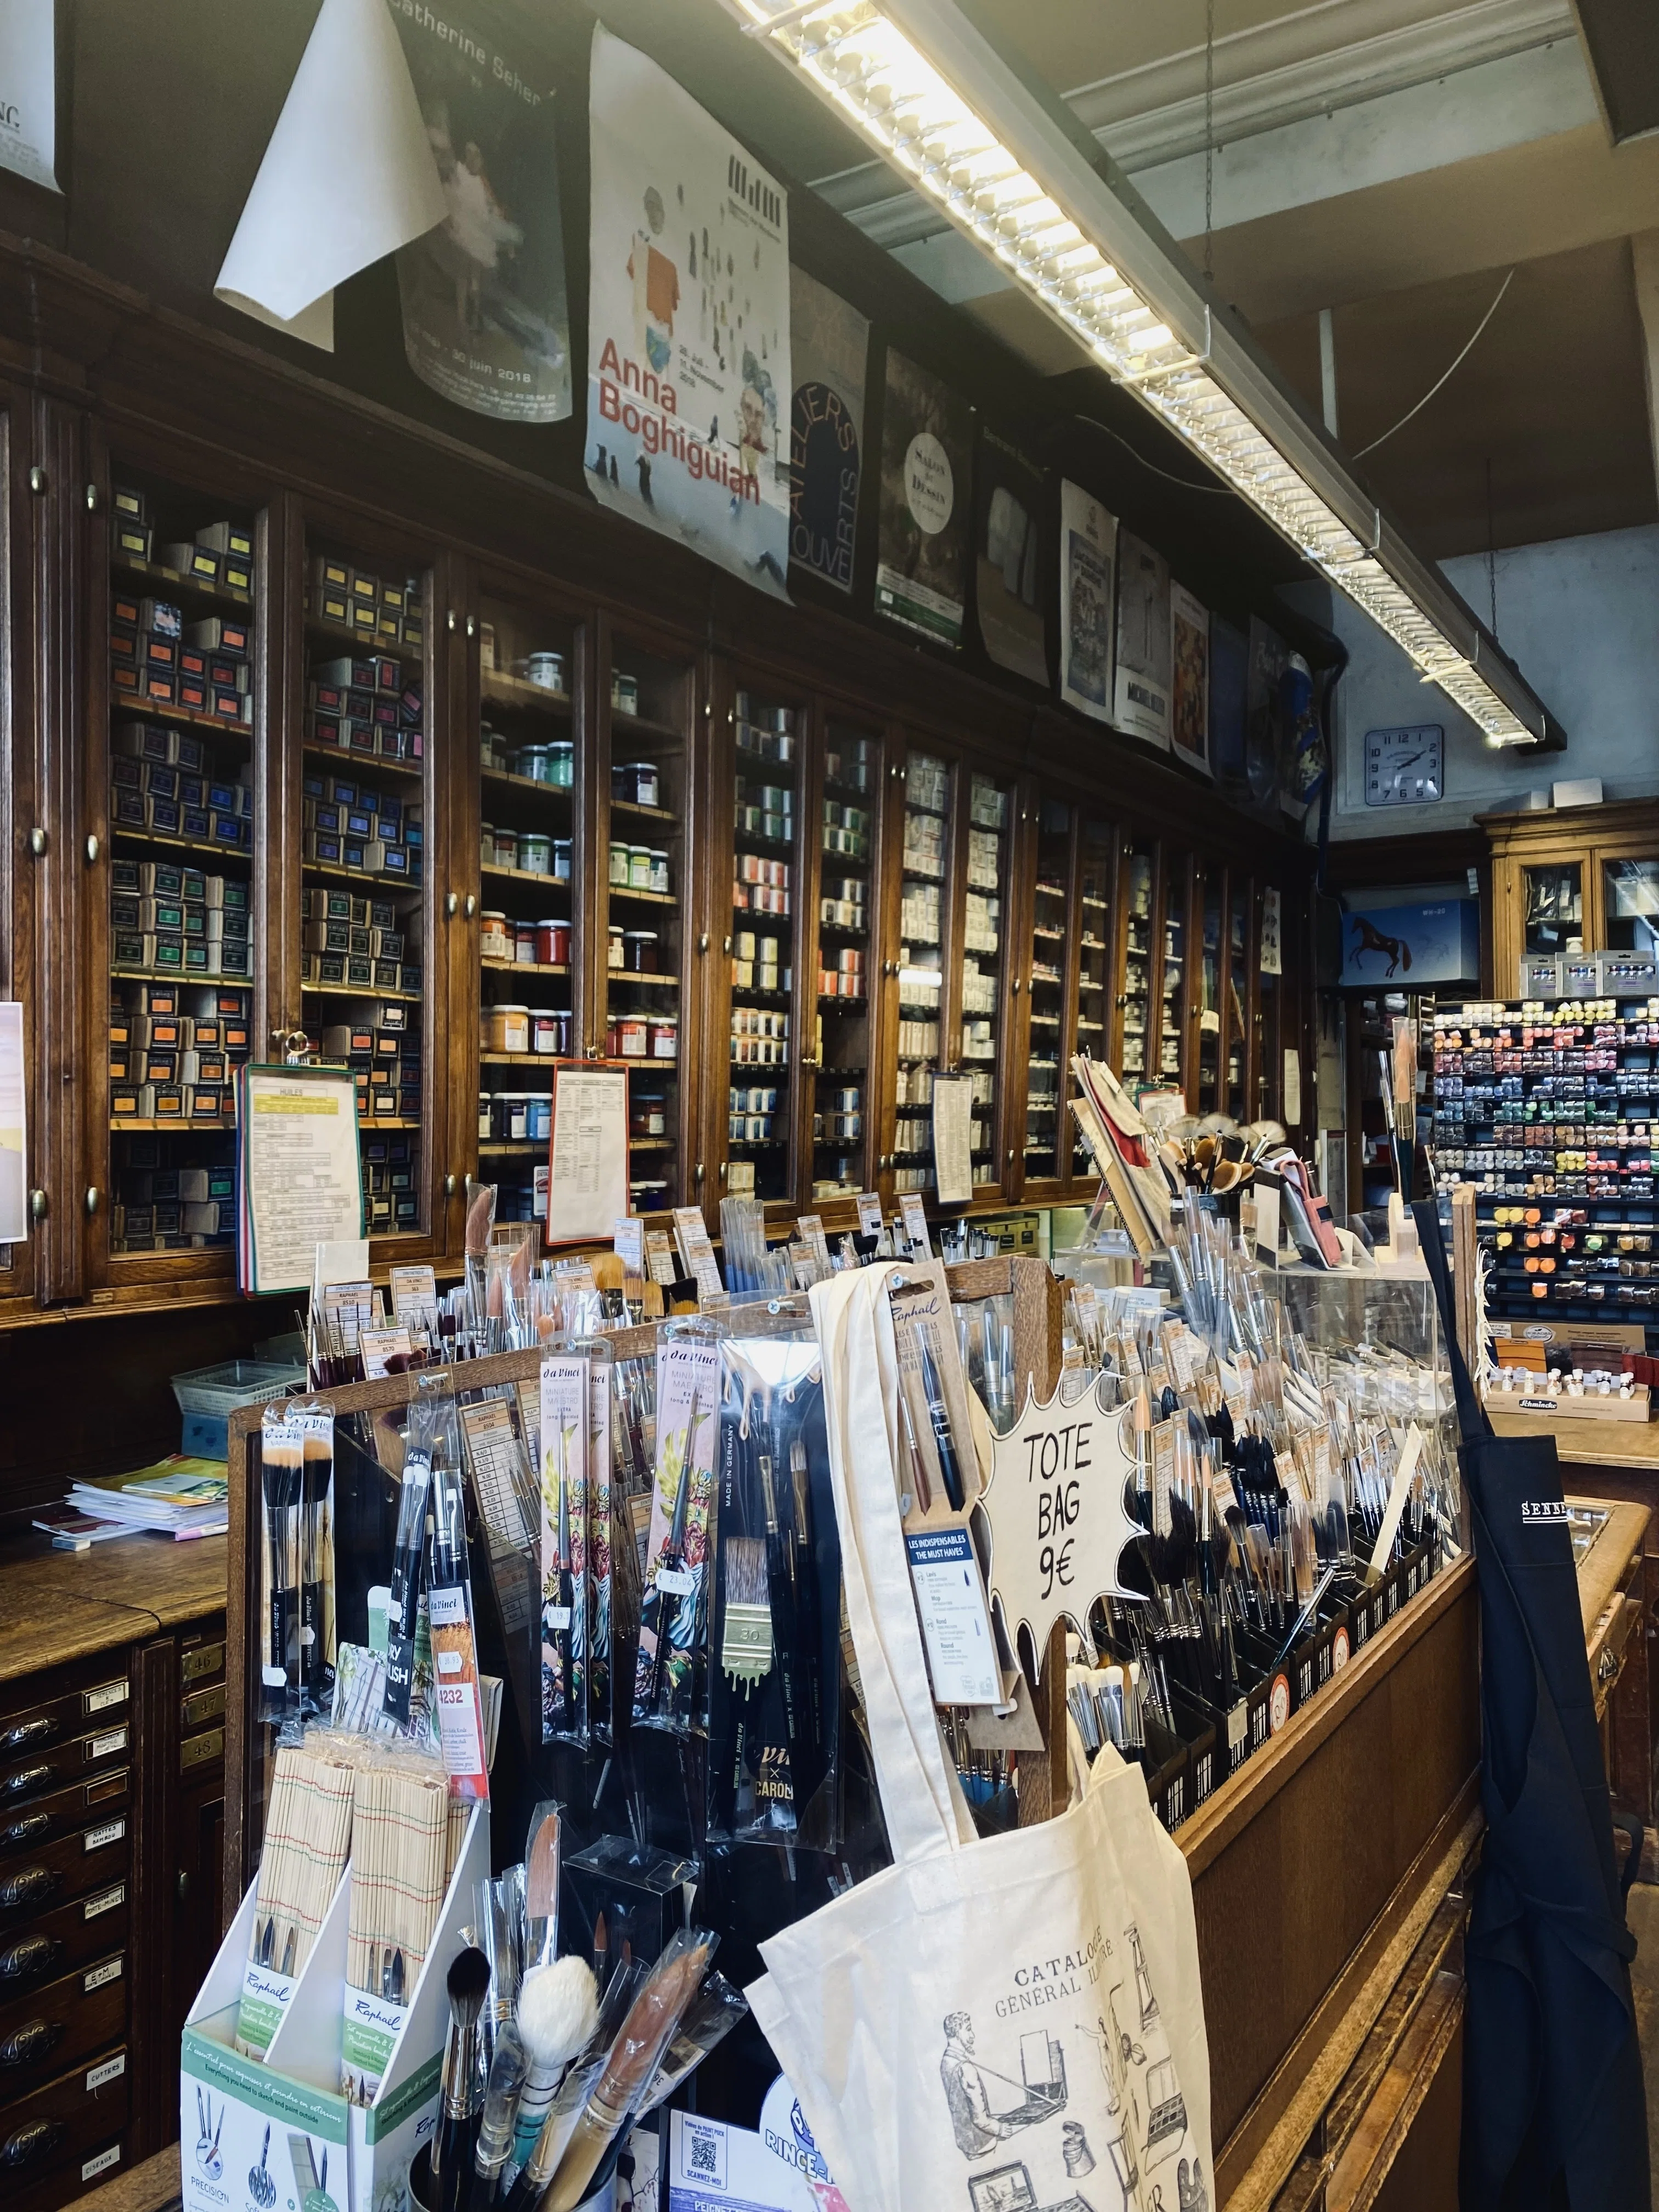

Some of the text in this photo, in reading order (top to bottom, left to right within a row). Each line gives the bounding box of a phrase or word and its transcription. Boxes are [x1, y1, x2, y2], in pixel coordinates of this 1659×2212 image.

[600, 338, 677, 415] Anna
[600, 377, 760, 505] Boghiguian
[1398, 734, 1409, 743] 12
[1371, 743, 1437, 757] 10 2
[1372, 759, 1437, 772] 9 3
[1383, 787, 1424, 799] 7 6 5
[279, 1088, 303, 1097] HUILES
[672, 1370, 716, 1385] MINIATURE
[545, 1387, 579, 1396] MINIATURE
[1520, 1399, 1558, 1409] Schmincke
[478, 1414, 496, 1423] RAPHAEL
[1024, 1422, 1093, 1483] TOTE
[727, 1470, 732, 1479] IN
[1038, 1480, 1080, 1540] BAG
[909, 1534, 966, 1549] LES INDISPENSABLES
[916, 1547, 964, 1560] THE MUST HAVES
[1040, 1538, 1075, 1600] 9€
[669, 1575, 692, 1587] 23.04
[740, 1628, 759, 1641] 30
[194, 1654, 211, 1671] 46
[201, 1696, 216, 1714] 47
[194, 1740, 211, 1757] 48
[93, 1825, 116, 1838] NATTES
[93, 1833, 116, 1845] BAMBOU
[247, 1972, 290, 2001] Raphaël
[995, 1977, 1081, 2018] GÉNÉRAL
[356, 1999, 401, 2030] Raphaël
[91, 2063, 120, 2083] CUTTERS
[205, 2064, 230, 2084] Everything
[230, 2079, 239, 2087] you
[239, 2081, 252, 2092] need
[258, 2091, 274, 2103] sketch
[274, 2100, 285, 2109] and
[285, 2103, 298, 2115] paint
[299, 2108, 319, 2124] outside
[218, 2061, 234, 2073] pour
[235, 2069, 263, 2087] esquisser
[271, 2087, 298, 2103] peindre
[300, 2100, 308, 2109] en
[309, 2104, 342, 2123] extérieur
[701, 2130, 712, 2138] action
[703, 2126, 714, 2135] PAINT
[714, 2129, 725, 2137] PUCK
[86, 2154, 112, 2175] CISEAUX
[687, 2169, 722, 2187] SCANNEZ-MOI
[191, 2176, 230, 2204] PRECISION
